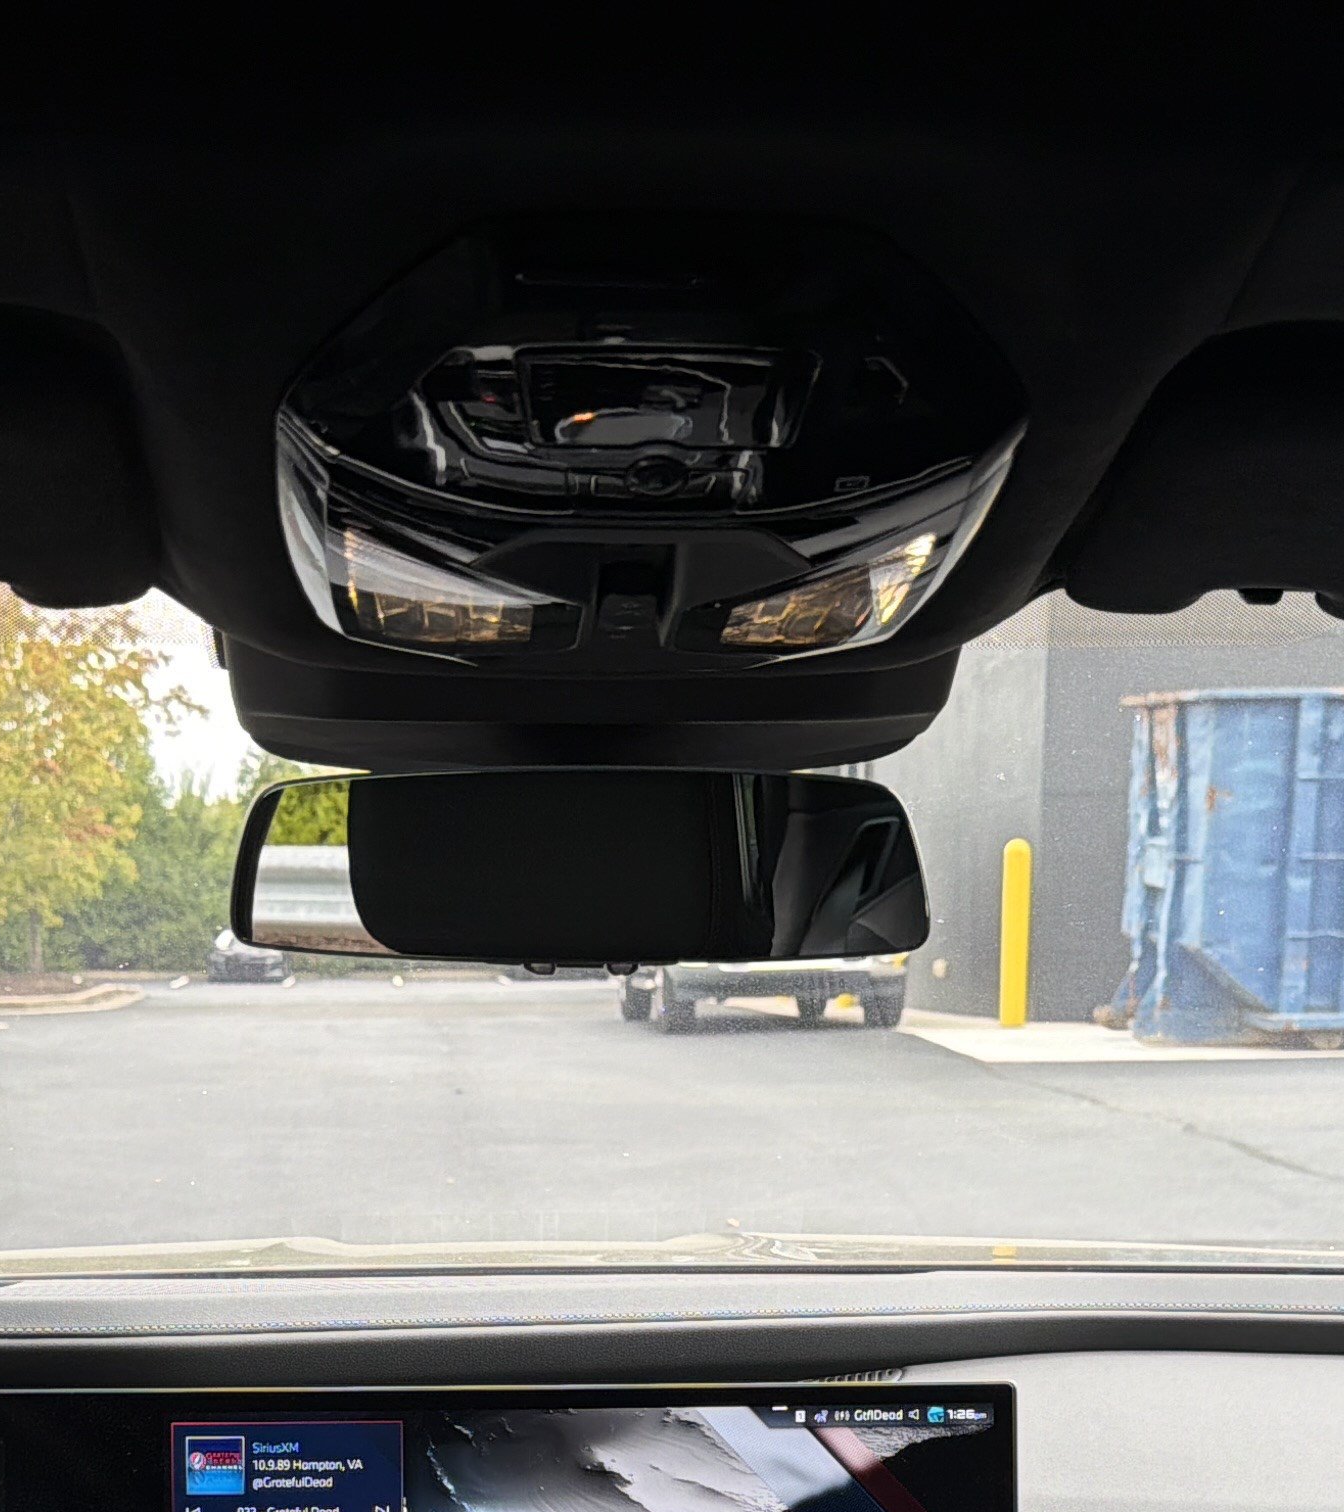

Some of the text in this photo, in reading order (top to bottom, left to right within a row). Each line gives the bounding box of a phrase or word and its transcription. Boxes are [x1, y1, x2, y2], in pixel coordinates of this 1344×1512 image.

[252, 1442, 299, 1454] SiriusXM
[252, 1459, 290, 1471] 10.9.89
[292, 1459, 345, 1472] Hampton,
[347, 1458, 363, 1470] VA
[252, 1475, 333, 1491] @GratefulDead
